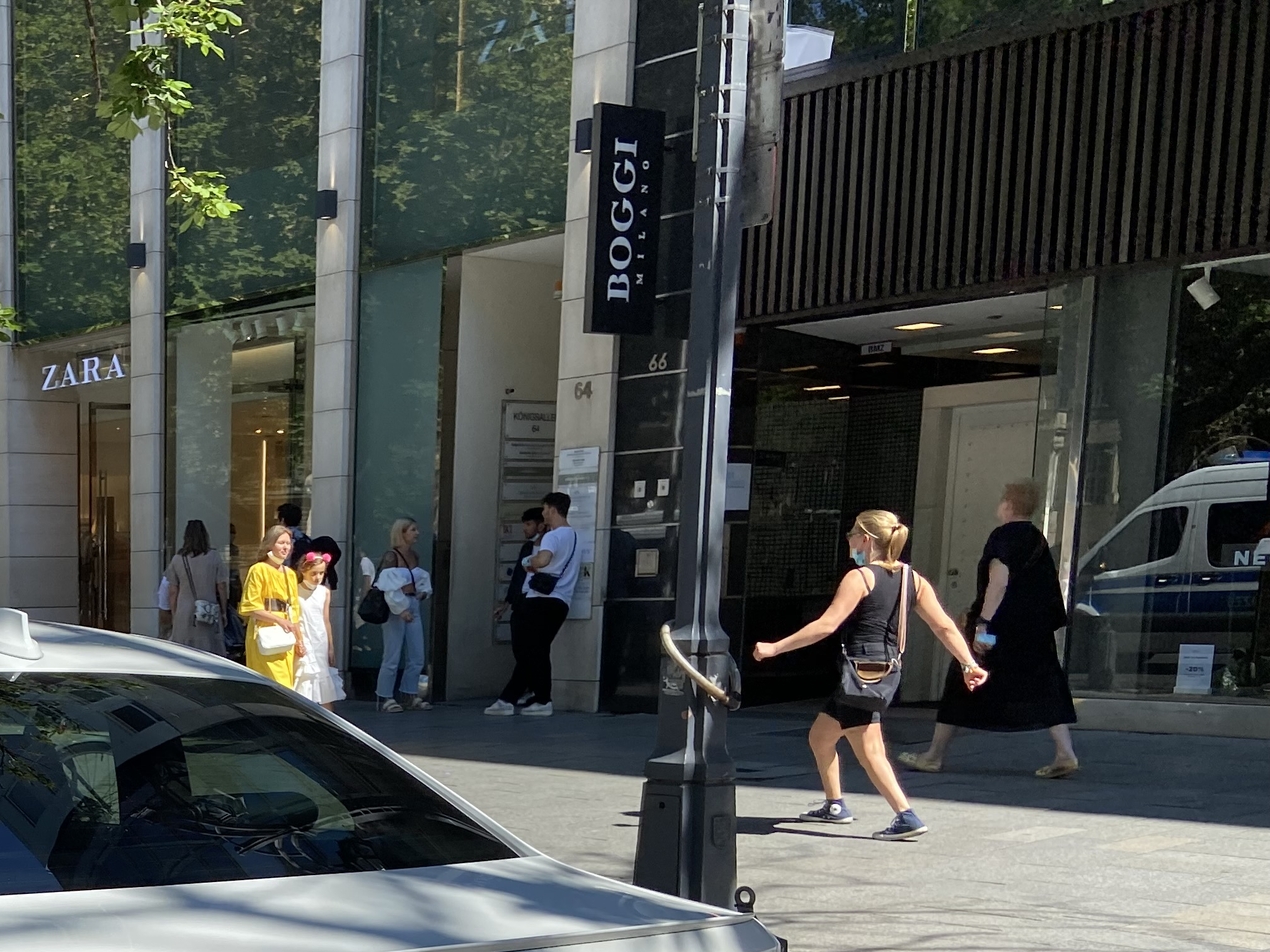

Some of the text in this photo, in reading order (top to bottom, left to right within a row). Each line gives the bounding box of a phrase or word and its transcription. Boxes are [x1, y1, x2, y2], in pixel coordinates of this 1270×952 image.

[608, 137, 639, 303] BOGGI
[635, 158, 650, 286] MILANO
[41, 353, 126, 391] ZARA
[648, 352, 668, 372] 66
[574, 381, 593, 400] 64
[513, 411, 556, 422] KÖNIGSALLE
[1233, 550, 1267, 566] NE
